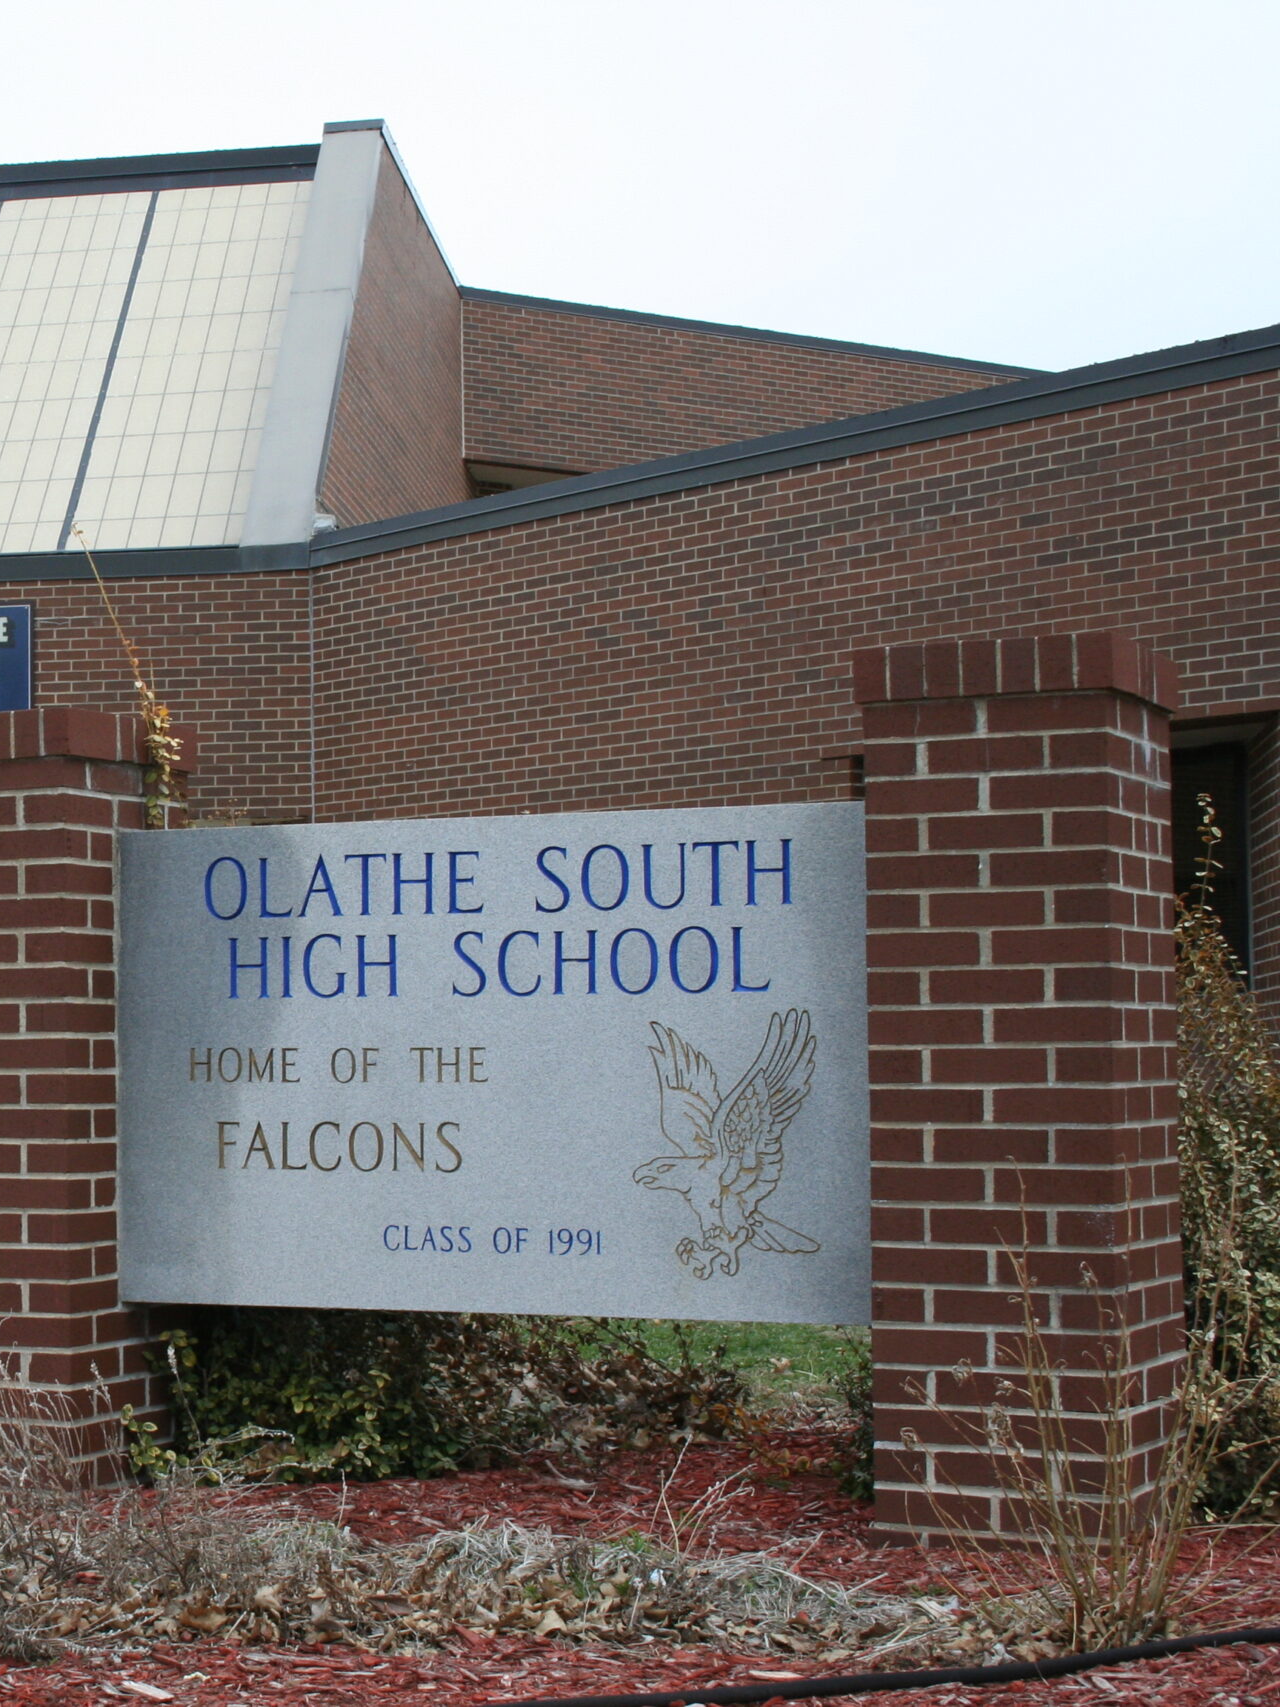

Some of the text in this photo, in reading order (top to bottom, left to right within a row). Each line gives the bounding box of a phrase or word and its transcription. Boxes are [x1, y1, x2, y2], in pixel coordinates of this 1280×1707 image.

[204, 838, 793, 920] OLATHE SOUTH
[227, 925, 772, 999] HIGH SCHOOL
[188, 1046, 489, 1084] HOME OF THE
[217, 1120, 463, 1174] FALCONS
[383, 1224, 602, 1256] CLASS OF 1991
